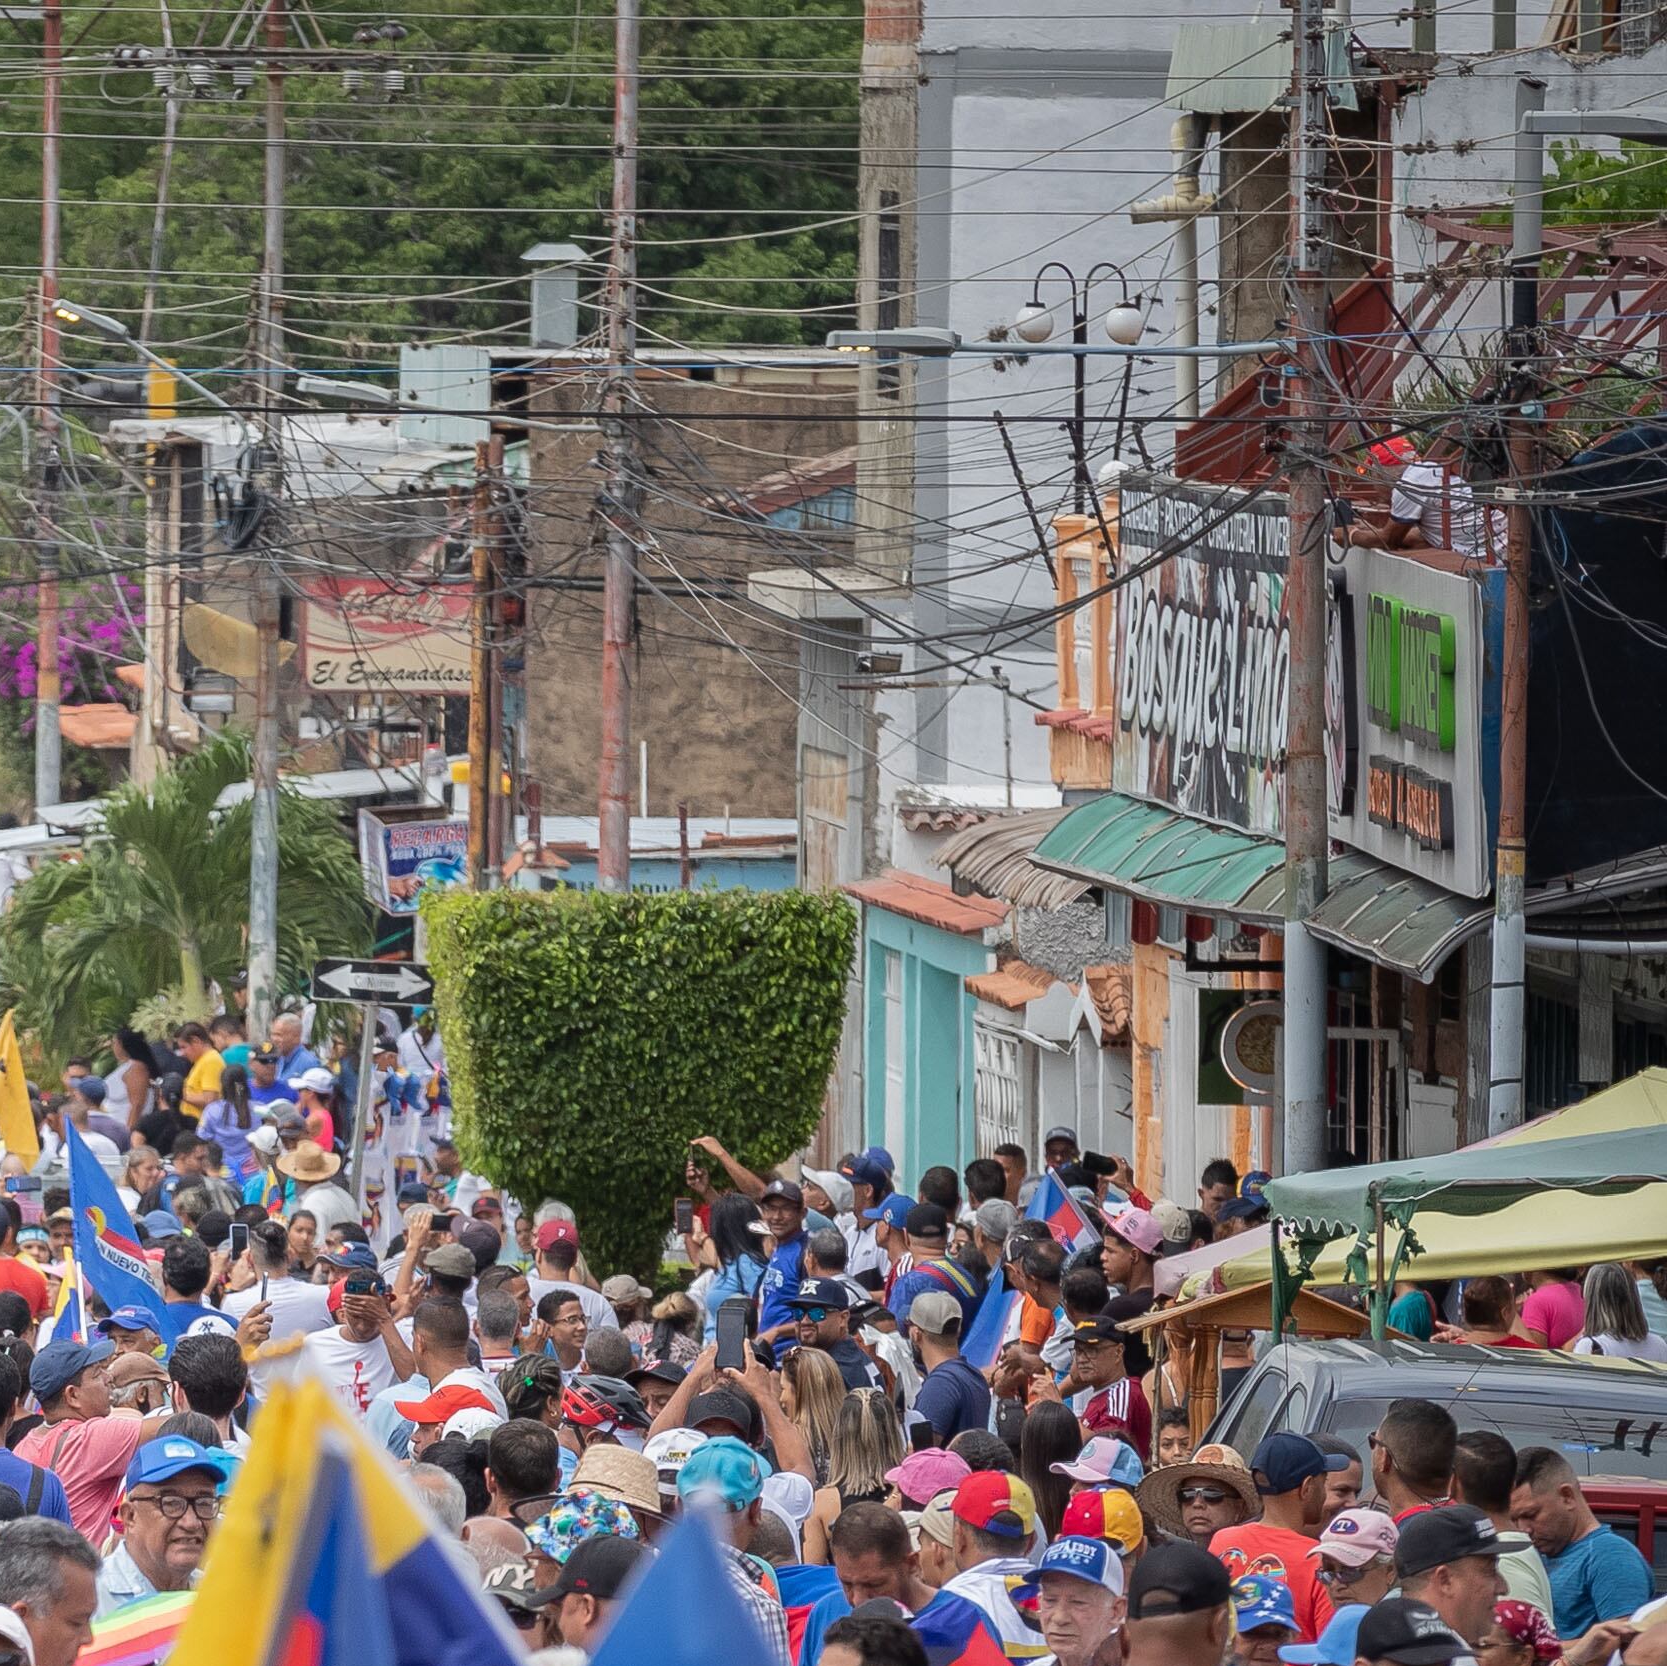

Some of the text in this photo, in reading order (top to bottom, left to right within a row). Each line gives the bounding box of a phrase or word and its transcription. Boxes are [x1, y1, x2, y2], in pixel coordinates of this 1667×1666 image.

[312, 660, 334, 684] El
[1121, 575, 1223, 788] Bosque
[1367, 593, 1451, 750] MINI MARKET
[107, 1249, 140, 1274] NUEVO
[1335, 1519, 1352, 1533] T
